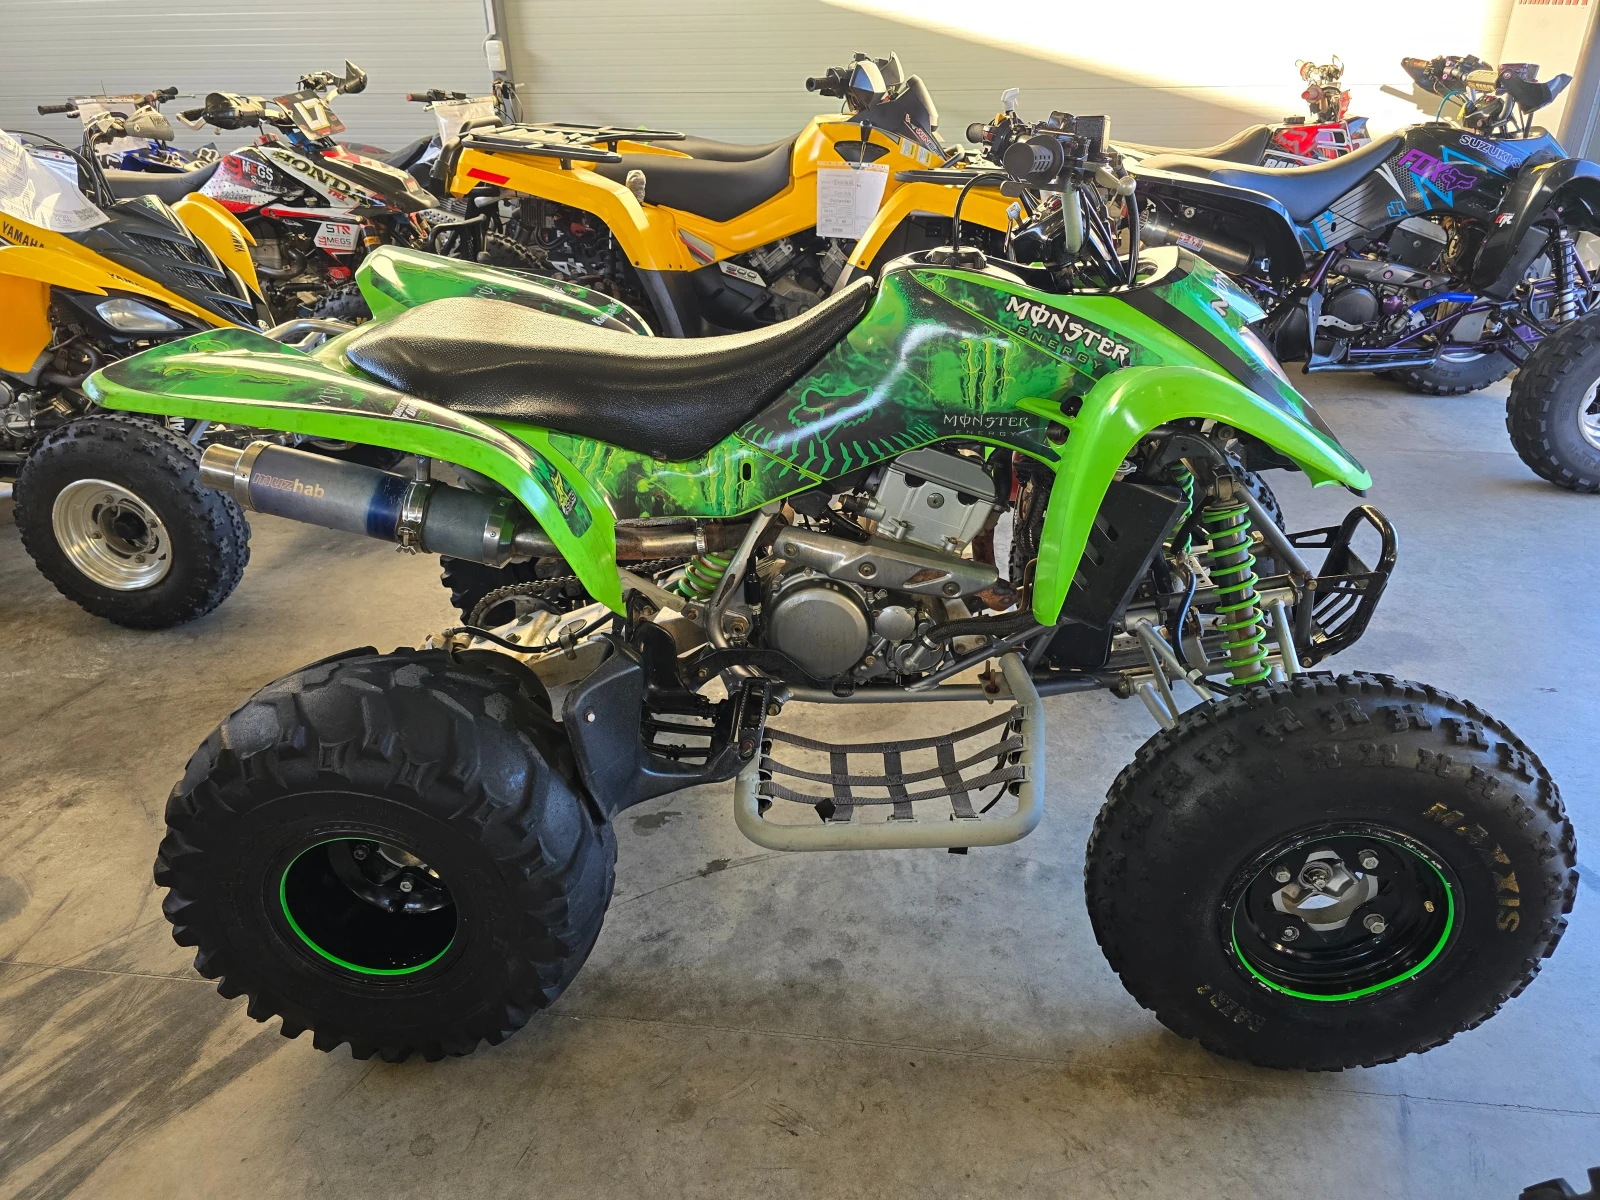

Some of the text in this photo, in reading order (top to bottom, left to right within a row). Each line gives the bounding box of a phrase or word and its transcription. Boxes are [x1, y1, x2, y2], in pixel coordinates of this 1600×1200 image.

[1459, 134, 1512, 164] SUZUKI
[241, 159, 274, 182] MEGS
[1397, 148, 1452, 183] FOX
[271, 150, 368, 208] HONDA
[327, 187, 347, 202] TRX
[326, 237, 352, 246] MEGS
[1016, 325, 1103, 370] ENERGY
[943, 413, 1030, 429] MONSTER
[955, 429, 1019, 437] ENERGY
[1421, 801, 1520, 933] MAXXIS
